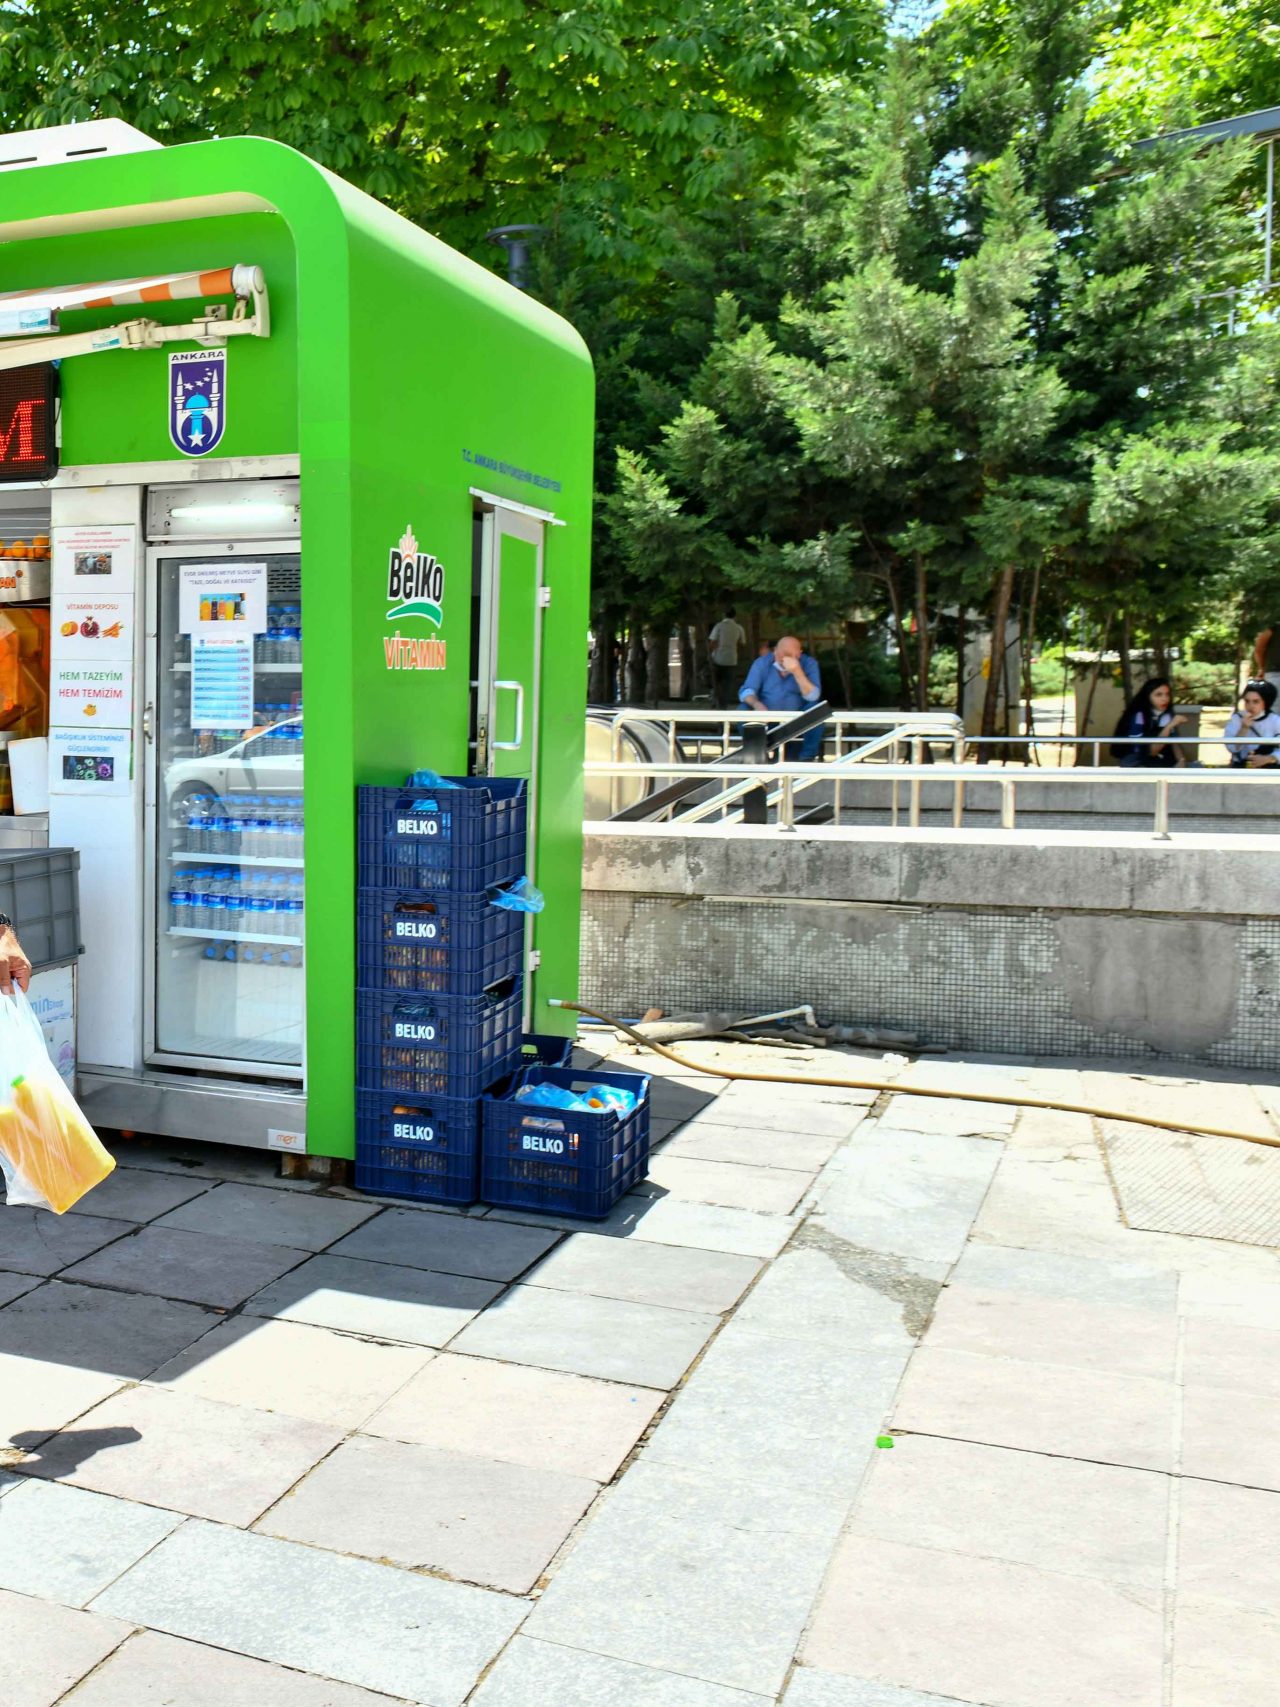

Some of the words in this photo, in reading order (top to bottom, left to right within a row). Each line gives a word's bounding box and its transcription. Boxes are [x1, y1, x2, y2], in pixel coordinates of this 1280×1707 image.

[171, 350, 225, 361] ANKARA
[388, 550, 443, 603] BelKo
[66, 602, 93, 611] VİTAMİN
[383, 630, 446, 669] VİTAMİN
[59, 671, 80, 681] HEM
[82, 670, 123, 681] TAZEYİM
[59, 688, 80, 698] HEM
[82, 687, 123, 699] TEMİZİM
[397, 819, 438, 835] BELKO
[396, 922, 436, 938] BELKO
[395, 1023, 435, 1040] BELKO
[393, 1124, 434, 1141] BELKO
[522, 1136, 564, 1155] BELKO
